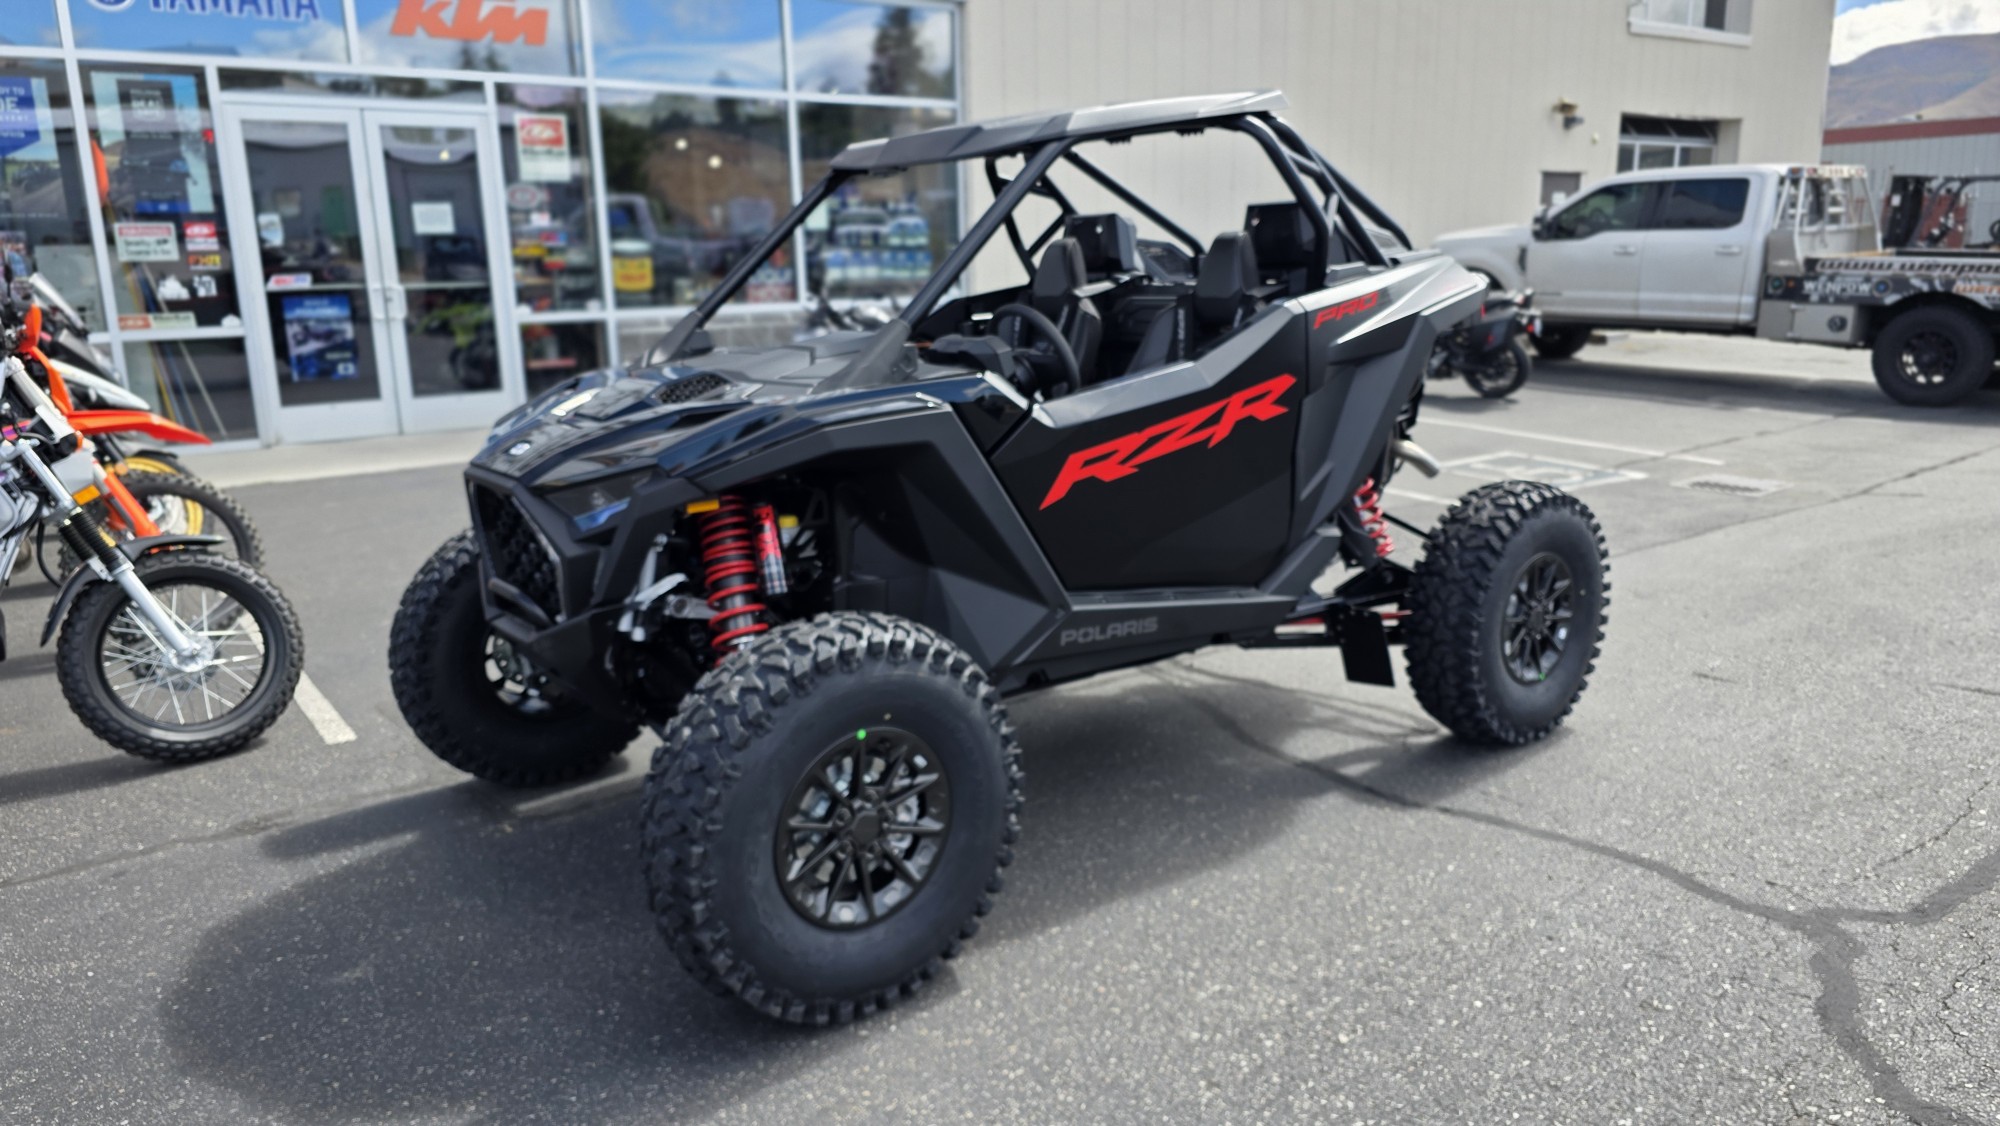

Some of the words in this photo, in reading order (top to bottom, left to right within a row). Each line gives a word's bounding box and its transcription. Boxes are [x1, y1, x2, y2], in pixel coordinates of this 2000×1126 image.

[151, 0, 319, 20] AHA
[390, 0, 548, 46] KTM
[1313, 290, 1379, 330] PRO
[1039, 373, 1297, 511] RZR
[1060, 616, 1159, 647] POLARIS
